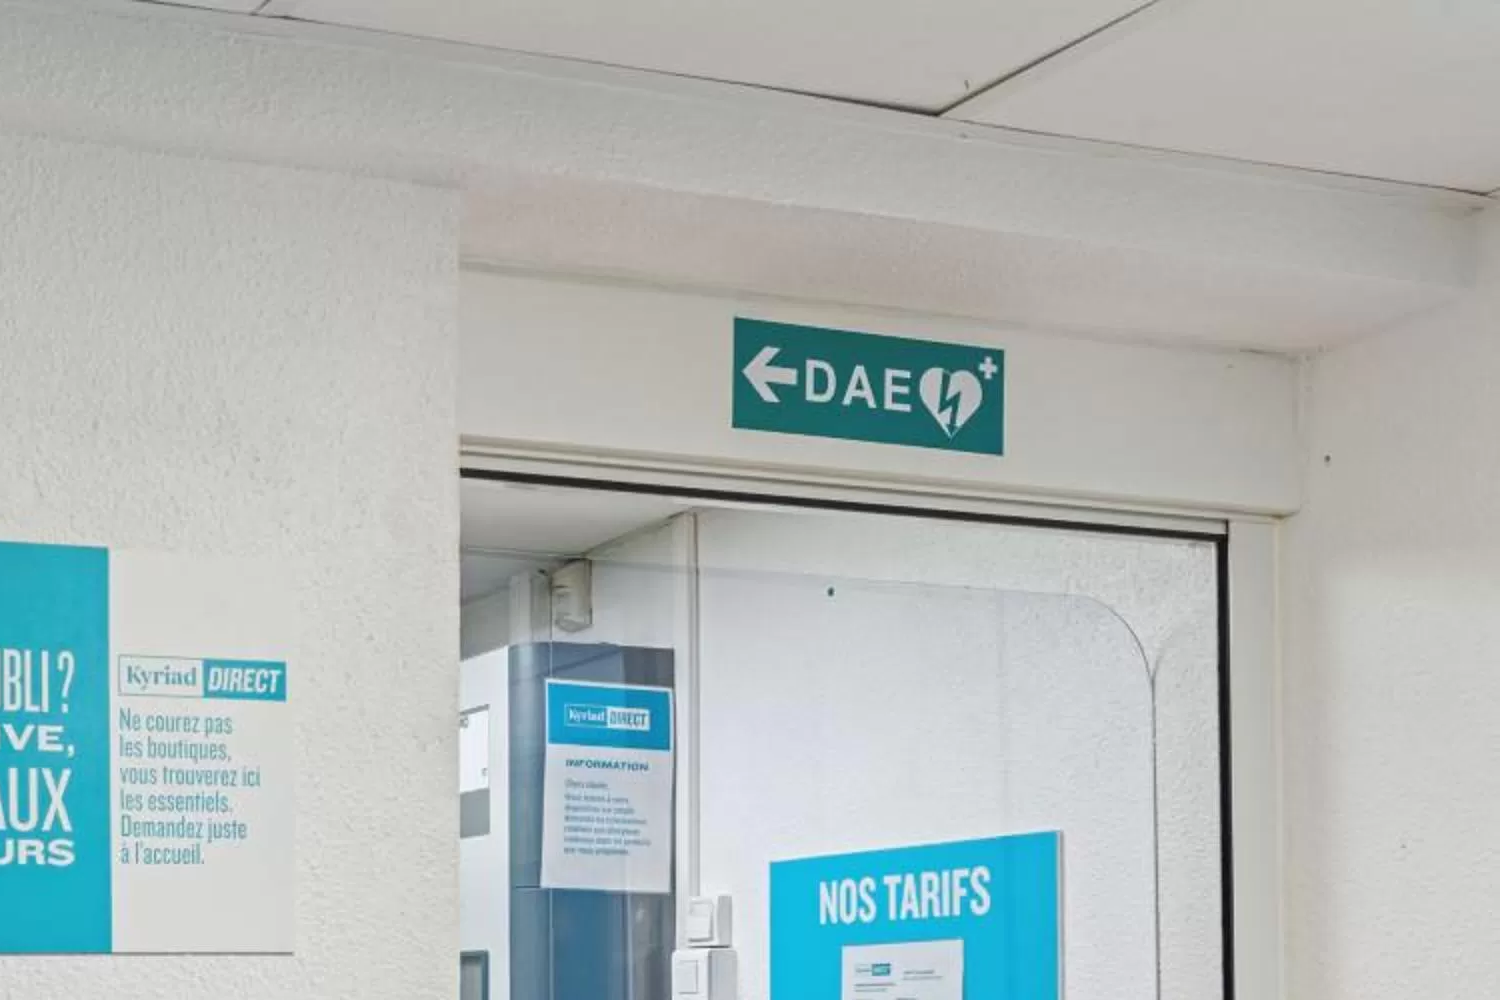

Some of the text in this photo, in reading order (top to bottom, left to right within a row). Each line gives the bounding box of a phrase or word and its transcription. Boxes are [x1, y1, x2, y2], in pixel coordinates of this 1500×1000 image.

[805, 358, 912, 413] DAE
[126, 664, 283, 694] Kyriad DIRECT
[118, 706, 234, 736] Ne courez pas
[119, 734, 232, 764] les boutiques,
[119, 765, 261, 787] vous trouverez ici
[565, 757, 650, 773] INFORMATION
[120, 788, 233, 813] les essentiels.
[120, 814, 248, 844] Demandez juste
[120, 841, 130, 865] à
[818, 865, 992, 926] NOS TARIFS
